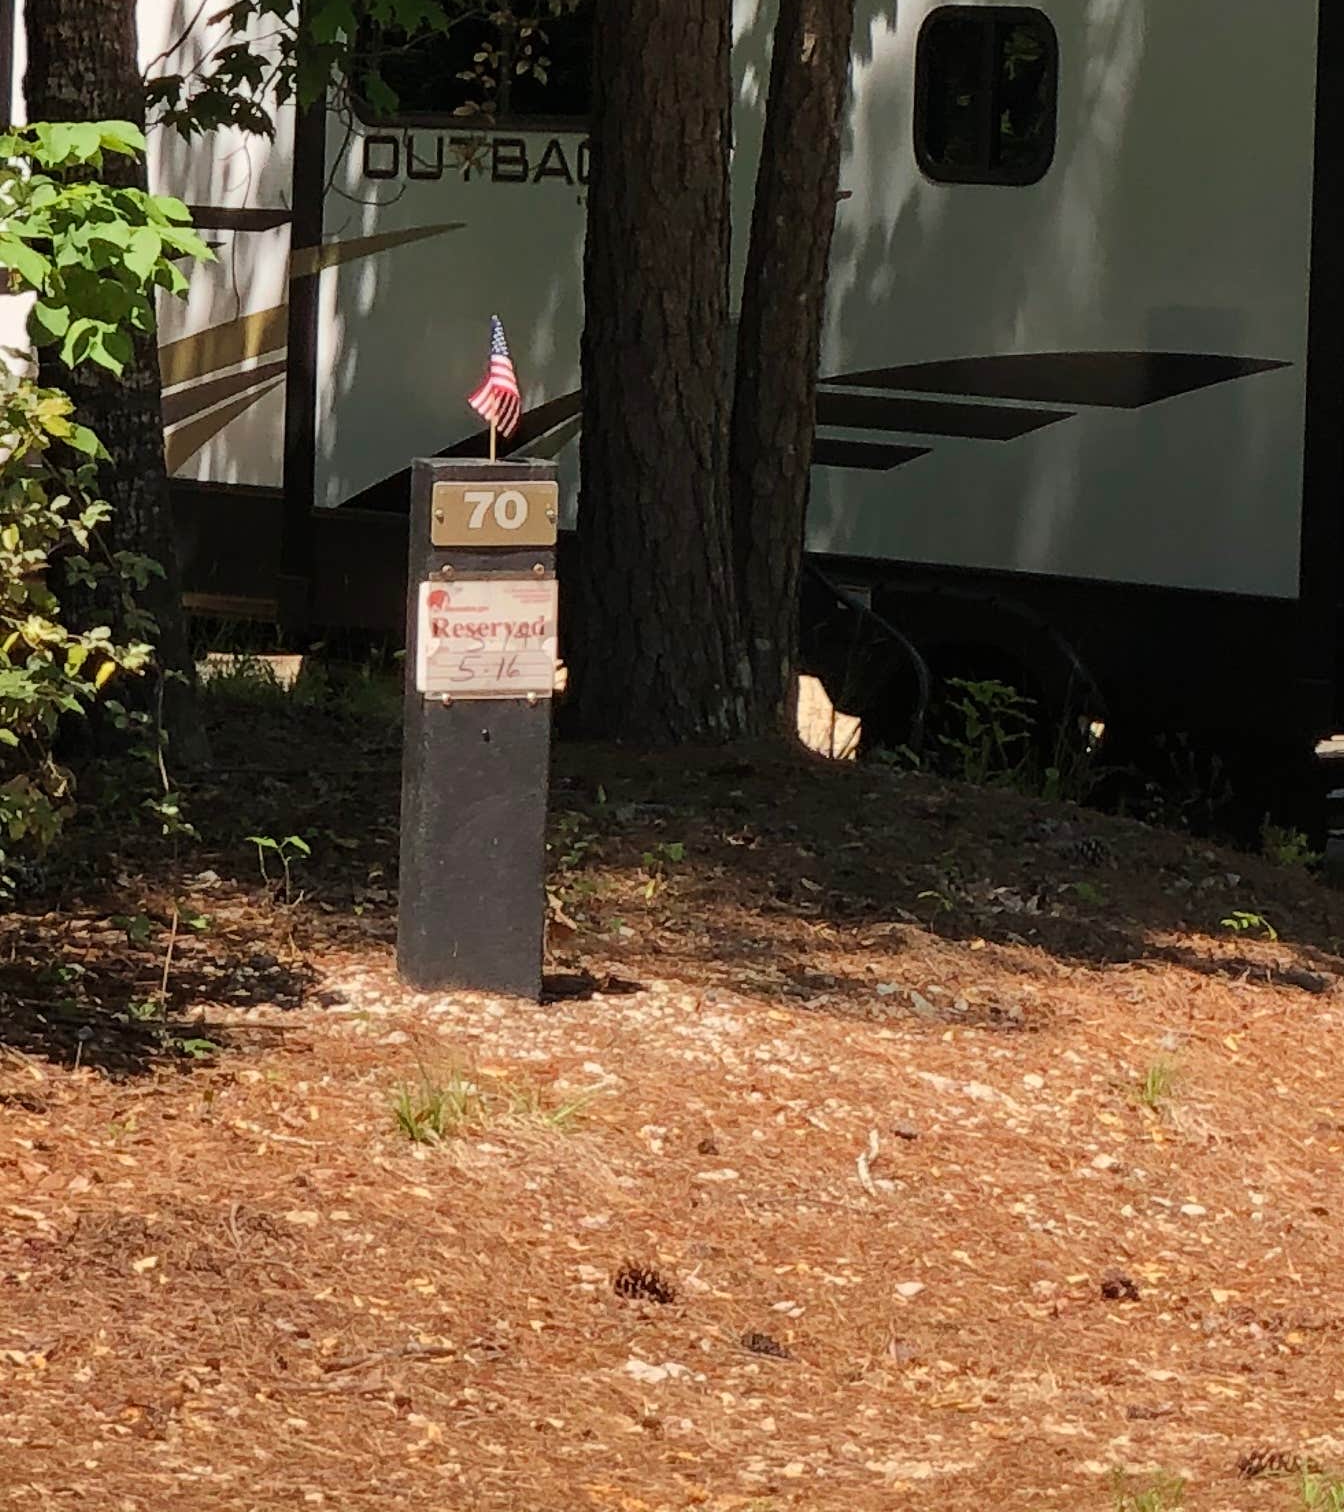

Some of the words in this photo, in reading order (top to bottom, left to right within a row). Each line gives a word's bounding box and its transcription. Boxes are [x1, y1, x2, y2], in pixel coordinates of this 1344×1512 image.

[363, 134, 591, 185] OUTBA
[463, 490, 529, 530] 70
[431, 615, 546, 638] Reserved
